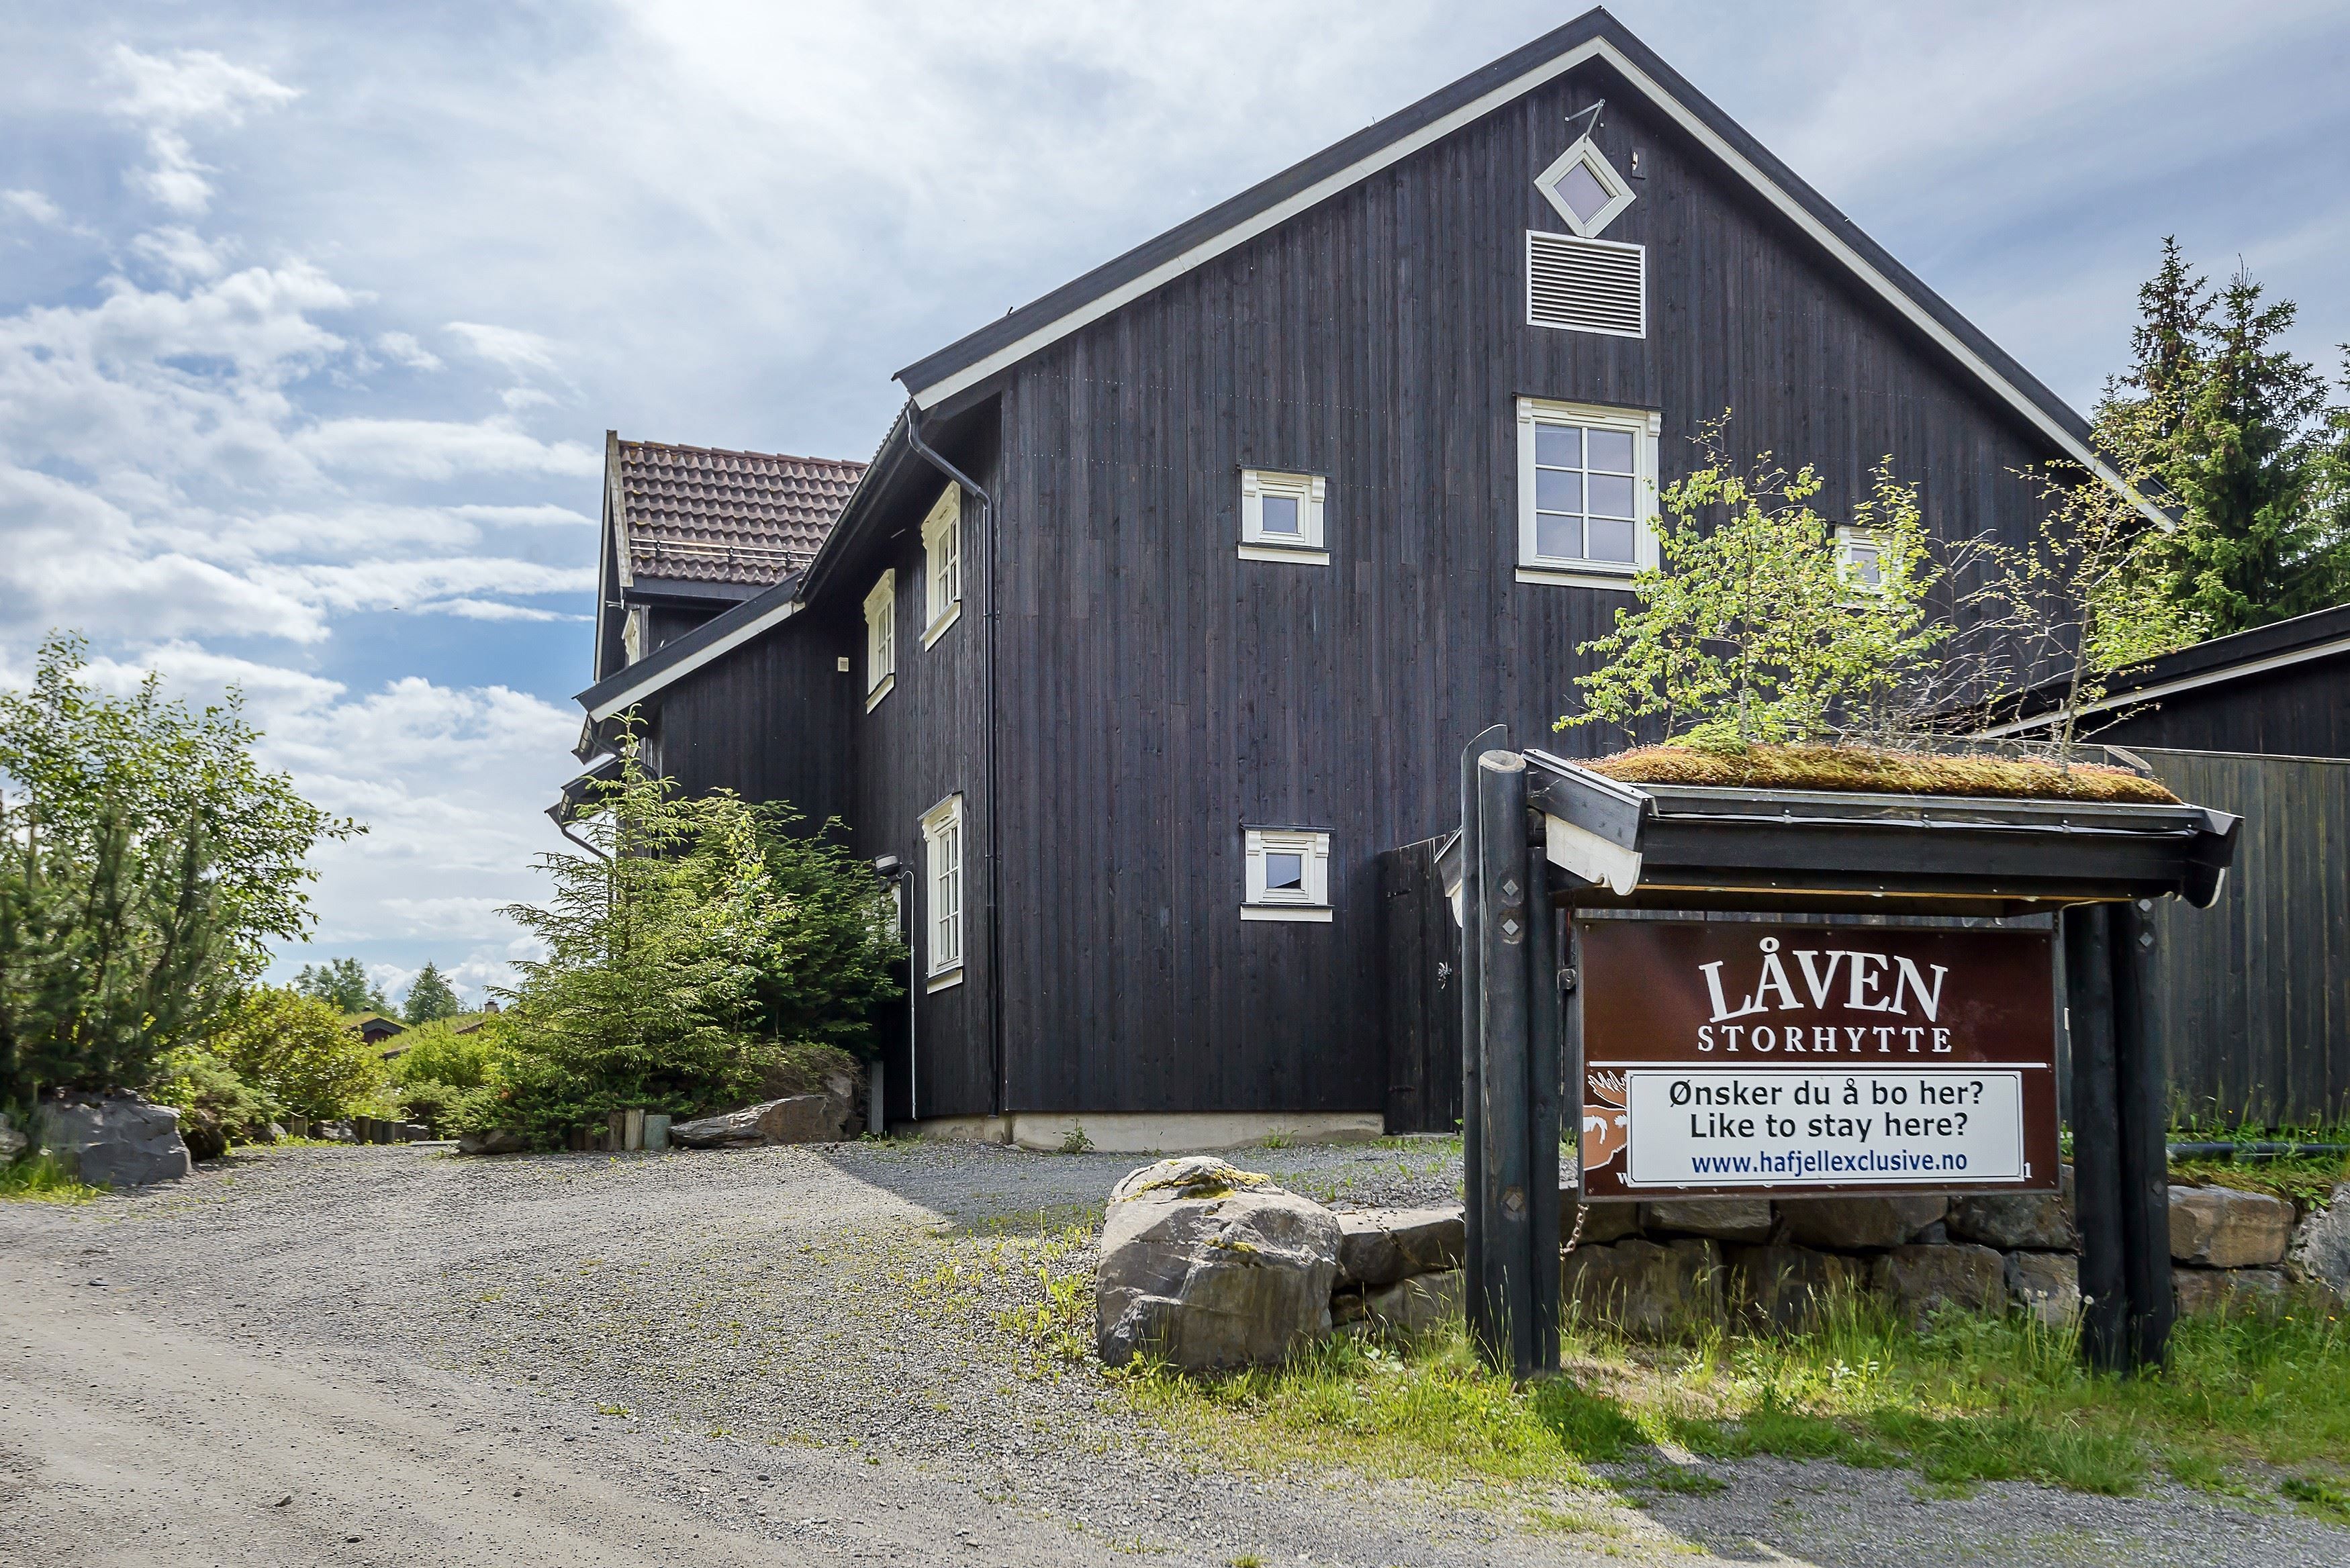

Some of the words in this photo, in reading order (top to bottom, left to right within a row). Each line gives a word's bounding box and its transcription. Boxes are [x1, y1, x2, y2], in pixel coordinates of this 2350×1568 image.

[1698, 936, 1948, 1024] LÅVEN
[1697, 1024, 1953, 1053] STORHYTTE
[1669, 1079, 1783, 1108] Ønsker
[1794, 1080, 1830, 1106] du
[1843, 1077, 1859, 1106] å
[1872, 1080, 1908, 1105] bo
[1920, 1080, 1983, 1105] her?
[1691, 1112, 1754, 1138] Like
[1765, 1114, 1796, 1138] to
[1807, 1114, 1873, 1143] stay
[1885, 1112, 1968, 1136] here?
[1691, 1149, 1967, 1177] www.hafjellexclusive.no
